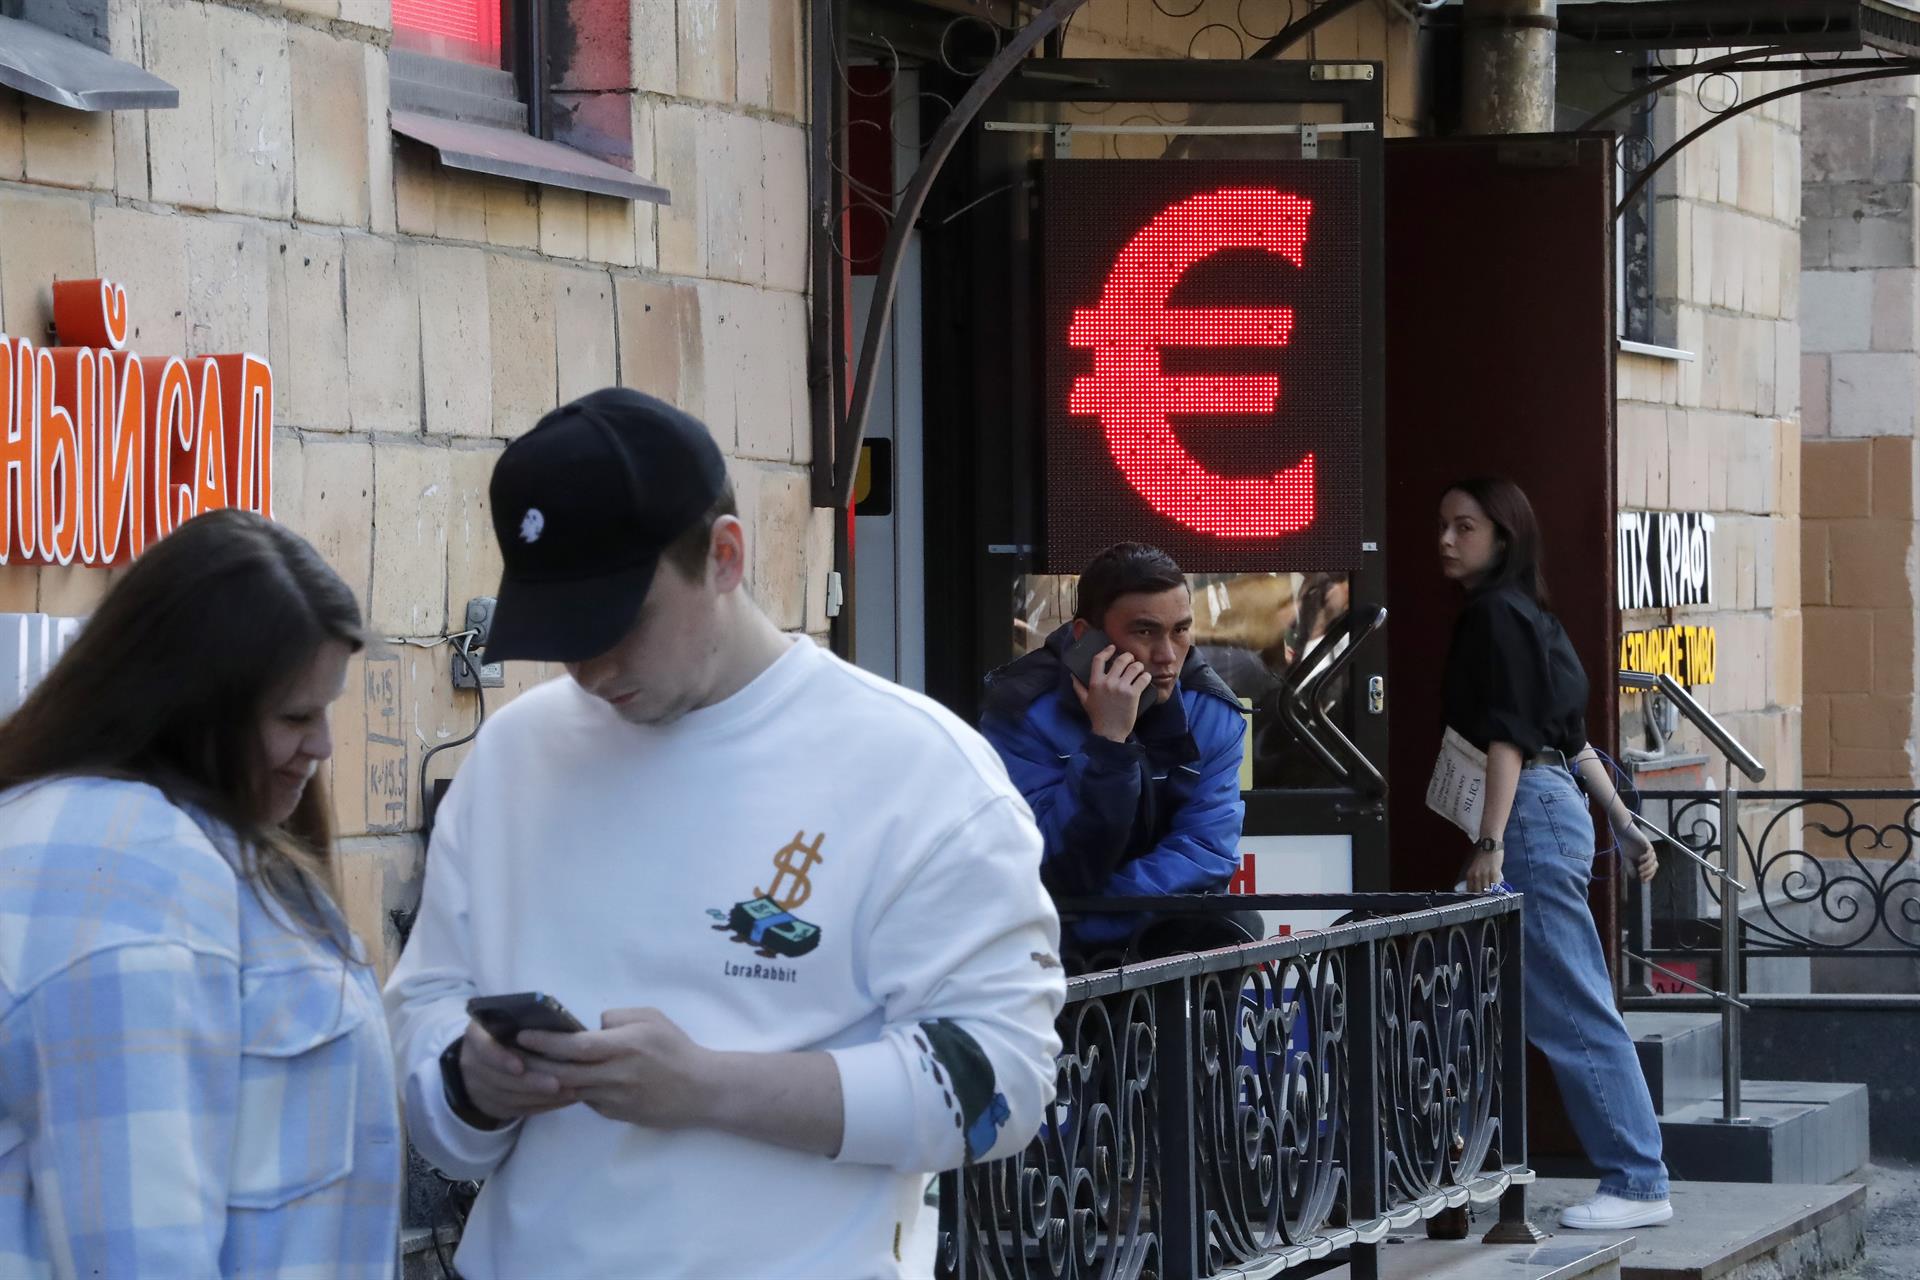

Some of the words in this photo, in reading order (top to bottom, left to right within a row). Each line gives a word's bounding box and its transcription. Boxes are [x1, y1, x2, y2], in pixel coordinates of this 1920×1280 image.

[1068, 186, 1316, 538] €
[1617, 511, 1653, 610] ПХ
[1658, 510, 1715, 608] КРАФТ
[1684, 625, 1716, 687] ПИВО
[1463, 777, 1481, 814] SILICA
[724, 959, 798, 983] LoraRabbit
